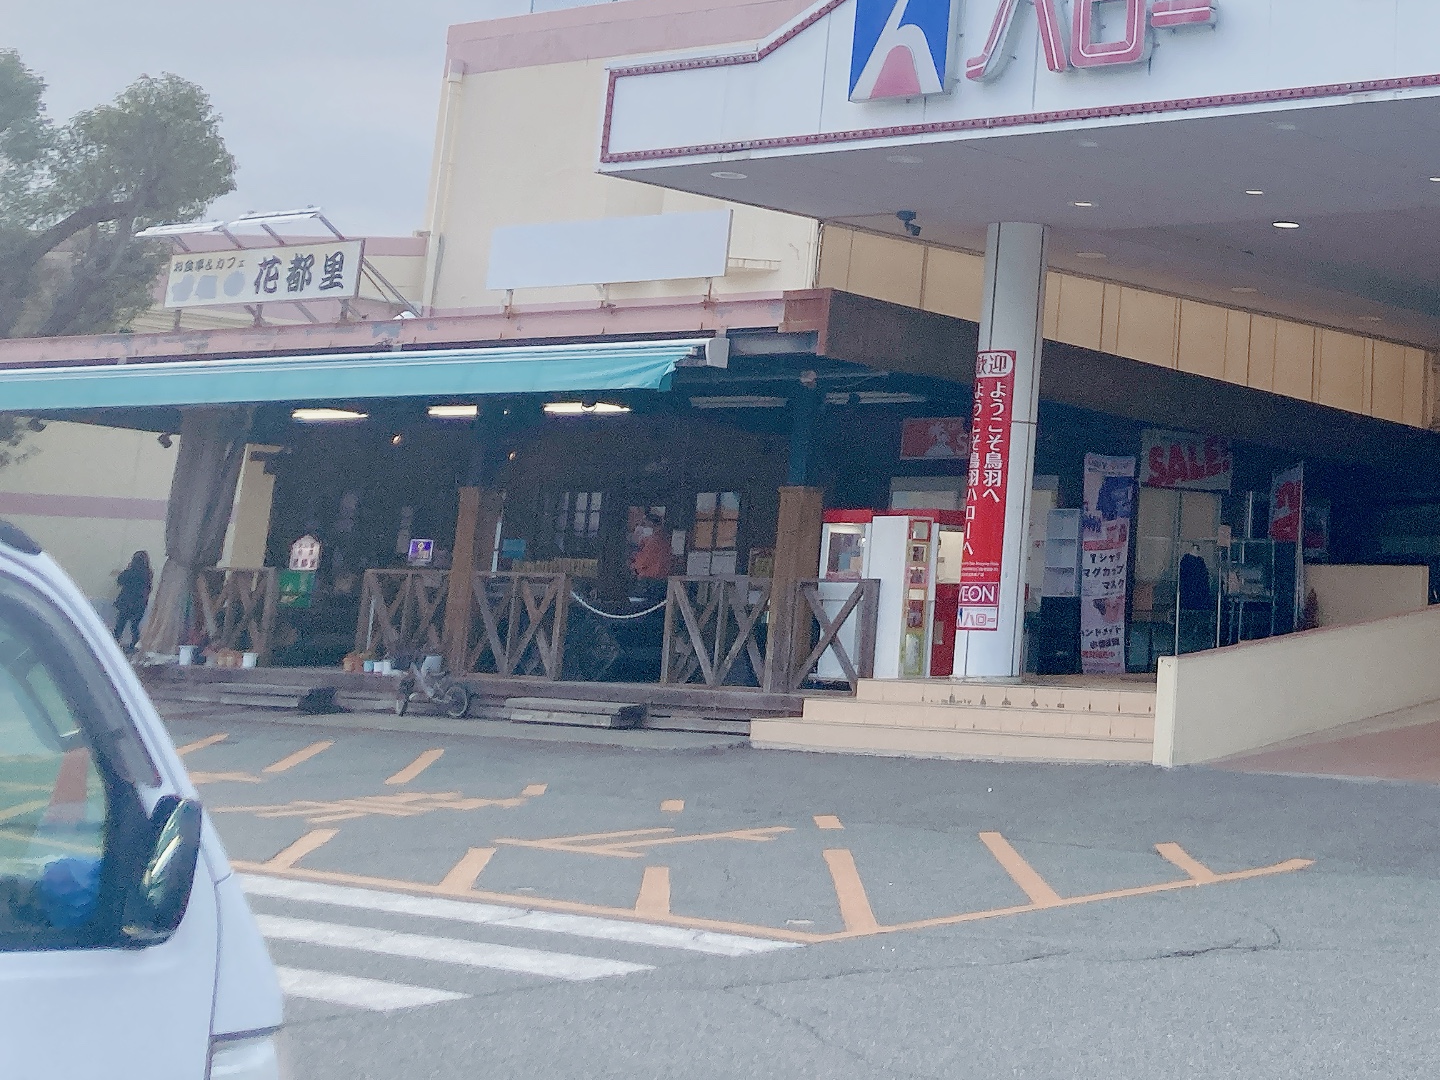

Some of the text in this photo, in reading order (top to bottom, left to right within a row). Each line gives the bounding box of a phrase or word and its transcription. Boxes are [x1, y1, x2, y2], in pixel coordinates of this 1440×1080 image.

[254, 251, 345, 295] 花都里
[982, 381, 1007, 503] ようこそ鳥羽へ
